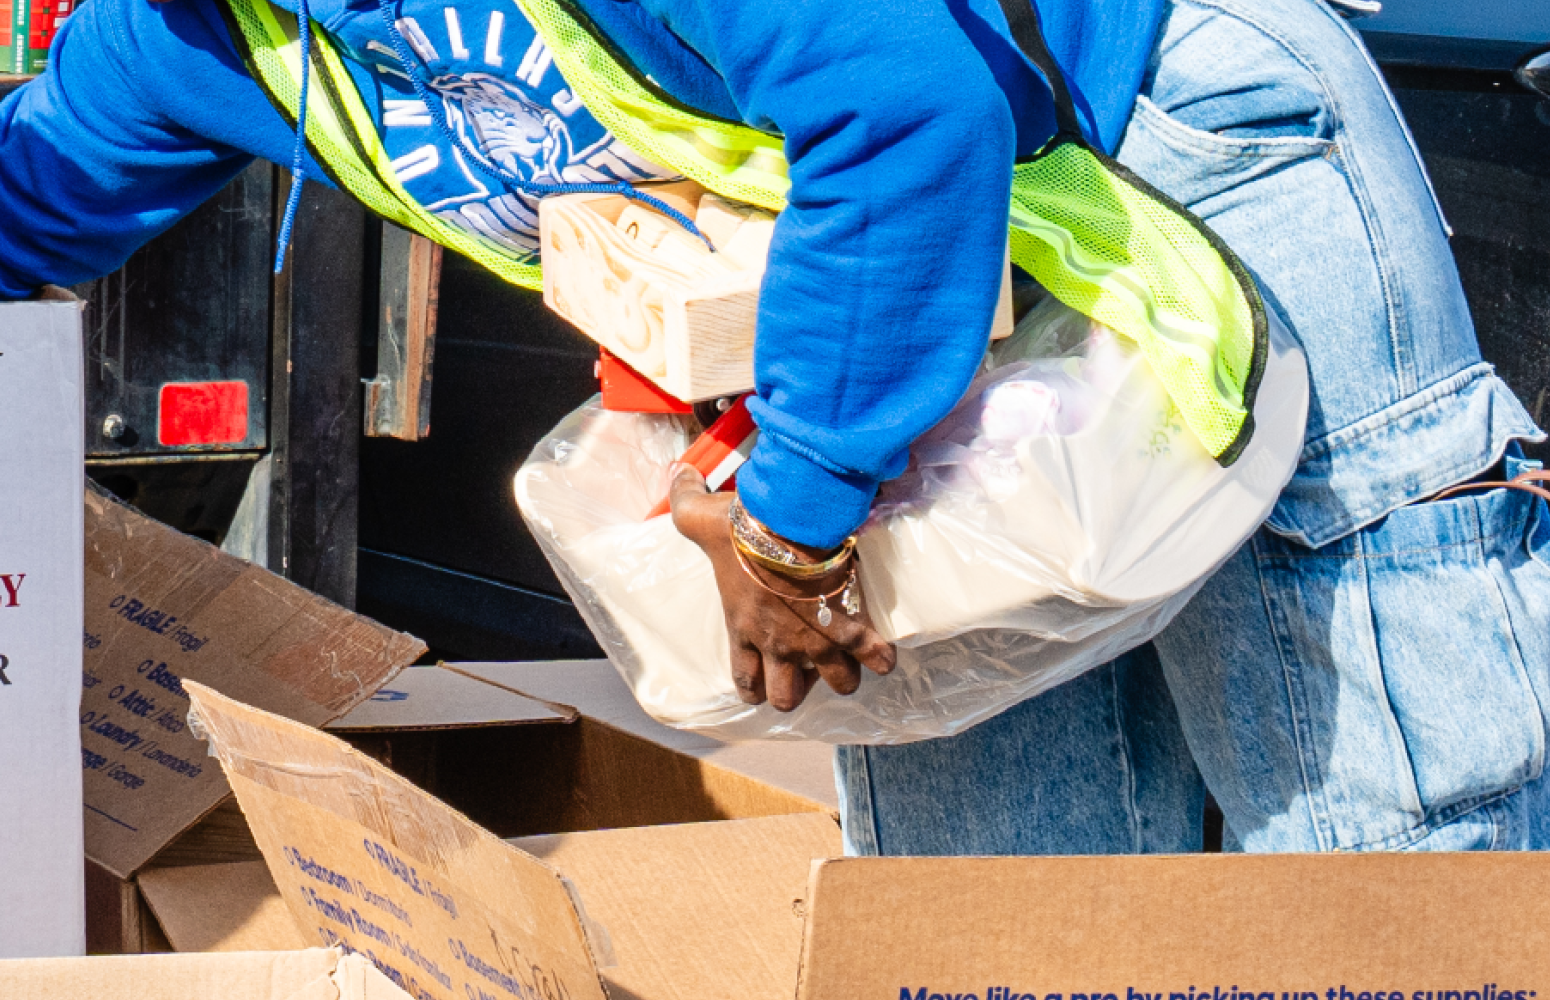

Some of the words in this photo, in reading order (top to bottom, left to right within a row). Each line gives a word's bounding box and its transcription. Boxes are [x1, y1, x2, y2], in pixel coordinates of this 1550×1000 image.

[120, 598, 177, 636] FRAGILE
[88, 714, 142, 752] Laundry
[291, 846, 354, 894] Bedroom
